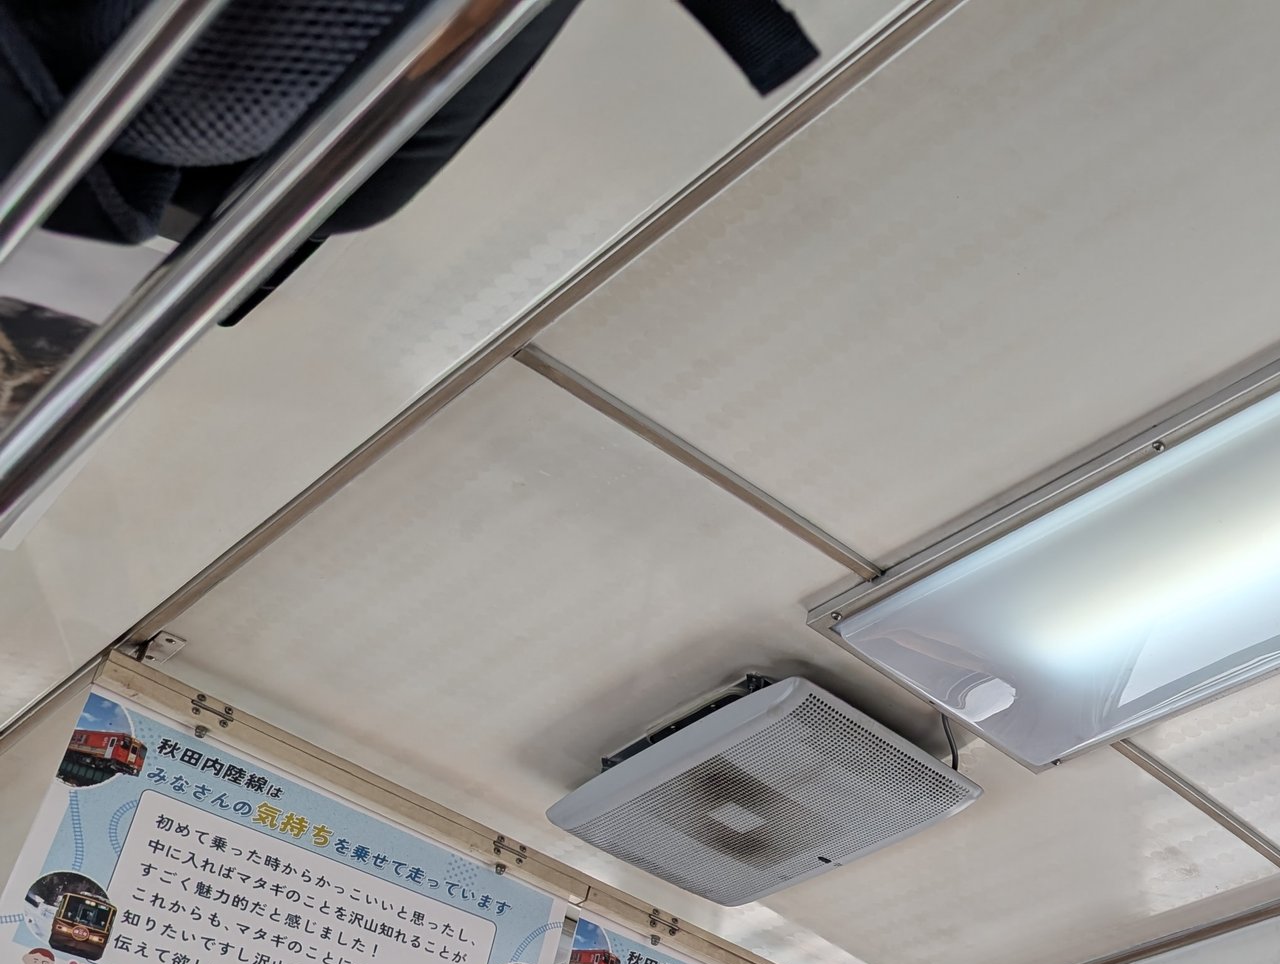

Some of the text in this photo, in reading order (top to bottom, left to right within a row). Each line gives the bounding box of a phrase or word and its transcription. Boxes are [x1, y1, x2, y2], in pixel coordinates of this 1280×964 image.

[157, 738, 284, 800] 秋田内陸線は
[147, 767, 511, 915] みなさんの気持ちを乗せて走っています
[148, 839, 467, 963] 中に入ればマタギのことを沢山知れることが
[156, 815, 476, 946] 初めて乗った時からかっこいいと思ったし、
[141, 863, 378, 957] すごく魅力的だと感じました！
